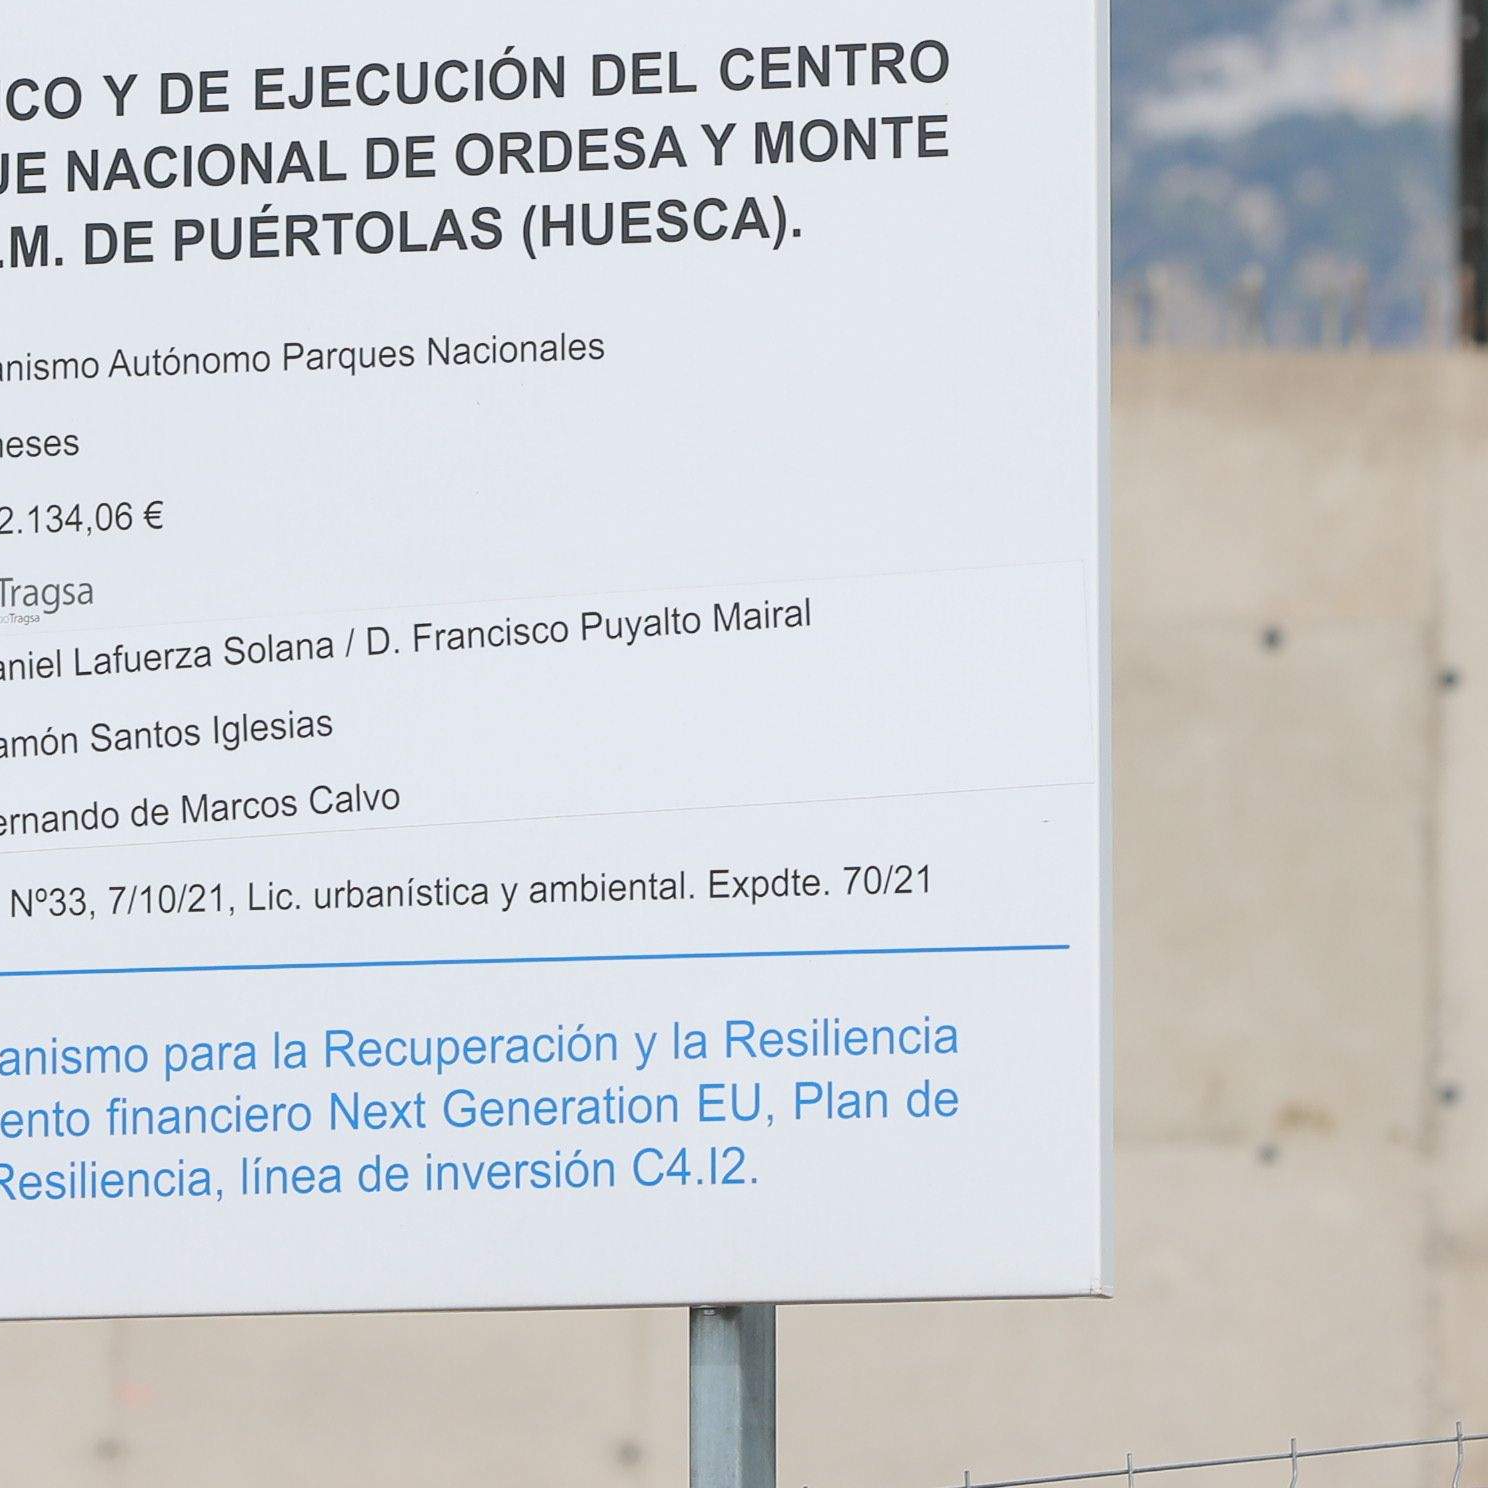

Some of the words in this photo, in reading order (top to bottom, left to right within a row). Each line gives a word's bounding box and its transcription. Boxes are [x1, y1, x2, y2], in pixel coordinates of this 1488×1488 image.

[101, 73, 139, 117] Y
[159, 69, 230, 115] DE
[254, 44, 565, 111] EJECUCIÓN
[591, 50, 698, 97] DEL
[719, 39, 950, 92] CENTRO
[66, 139, 348, 193] NACIONAL
[365, 134, 437, 181] DE
[454, 124, 688, 177] ORDESA
[699, 122, 738, 167] Y
[754, 114, 950, 165] MONTE
[84, 220, 155, 266] DE
[174, 202, 503, 262] PUÉRTOLAS
[522, 194, 802, 261] (HUESCA).
[107, 346, 271, 379] Autónomo
[283, 342, 416, 377] Parques
[427, 331, 605, 367] Nacionales
[142, 499, 164, 530] €
[74, 643, 212, 677] Lafuerza
[223, 633, 335, 666] Solana
[344, 627, 356, 658] /
[366, 625, 400, 656] D.
[413, 616, 570, 653] Francisco
[581, 606, 702, 647] Puyalto
[713, 596, 811, 633] Mairal
[90, 720, 201, 753] Santos
[213, 709, 334, 752] Iglesias
[130, 797, 170, 828] de
[181, 793, 298, 824] Marcos
[309, 782, 401, 815] Calvo
[10, 886, 96, 921] Nº33,
[108, 882, 235, 917] 7/10/21,
[248, 881, 301, 912] Lic.
[314, 876, 489, 910] urbanística
[500, 882, 519, 913] y
[528, 870, 695, 905] ambiental.
[709, 867, 830, 906] Expdte.
[842, 863, 929, 896] 70/21
[165, 1041, 257, 1083] para
[274, 1030, 307, 1070] la
[325, 1023, 618, 1076] Recuperación
[634, 1031, 658, 1072] y
[673, 1021, 708, 1060] la
[725, 1015, 959, 1059] Resiliencia
[105, 1094, 312, 1136] financiero
[330, 1091, 427, 1131] Next
[443, 1085, 678, 1129] Generation
[698, 1082, 774, 1128] EU,
[795, 1080, 888, 1120] Plan
[906, 1078, 959, 1118] de
[242, 1156, 342, 1196] línea
[357, 1153, 410, 1193] de
[426, 1148, 615, 1191] inversión
[632, 1145, 758, 1187] C4.I2.
